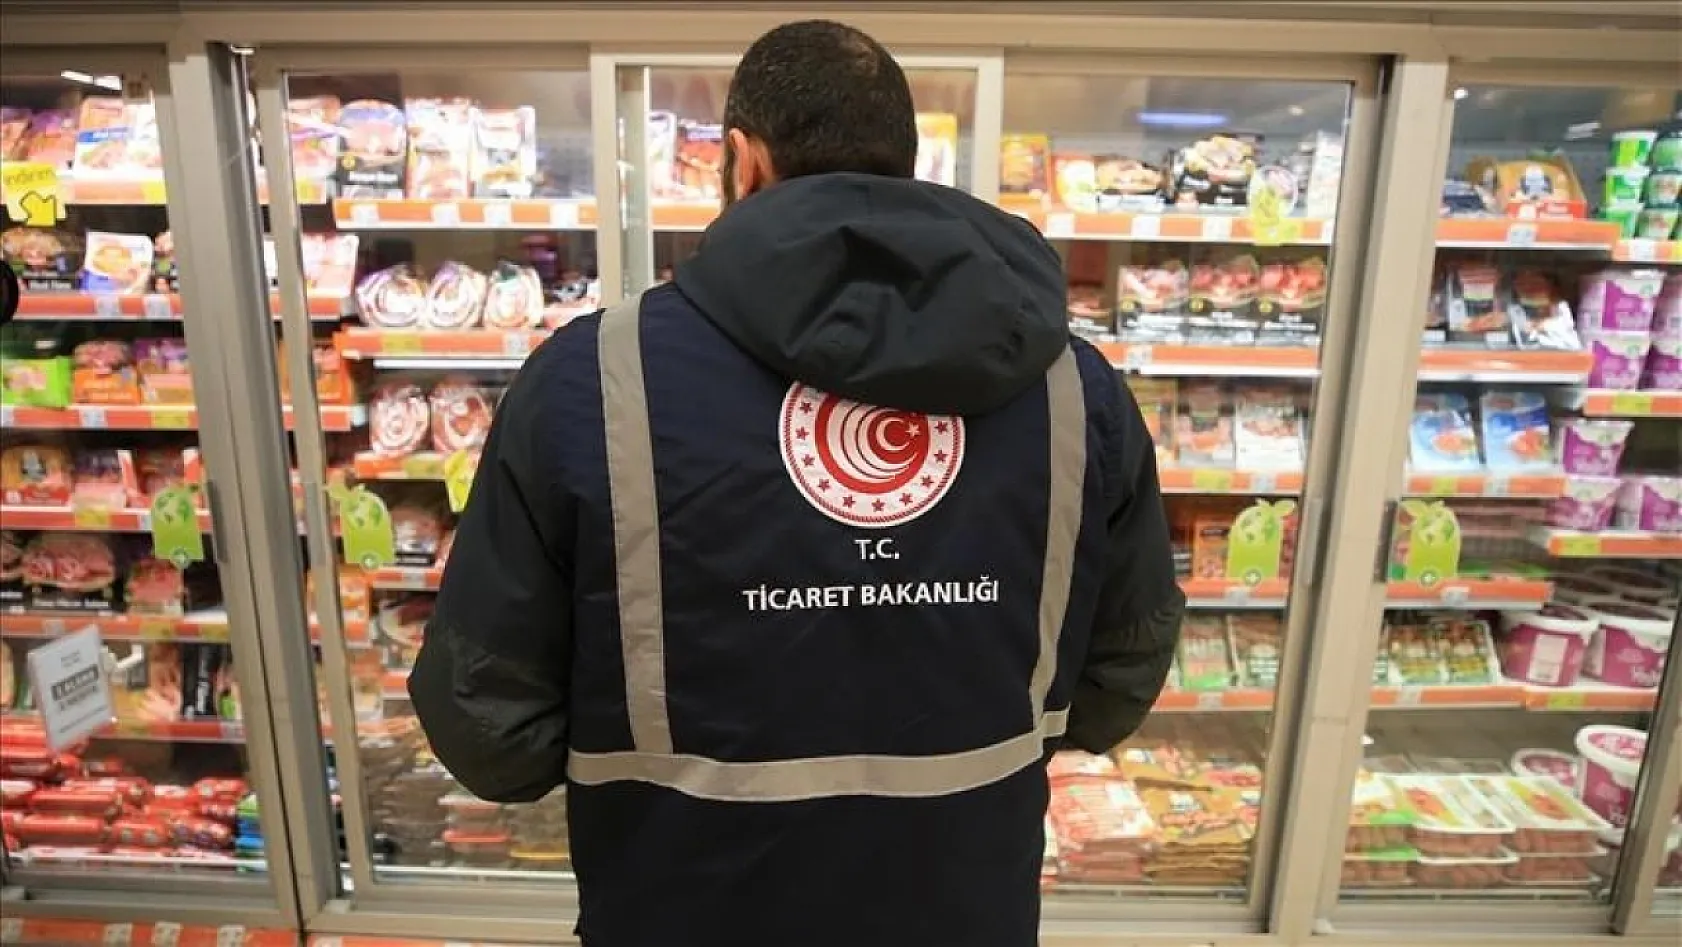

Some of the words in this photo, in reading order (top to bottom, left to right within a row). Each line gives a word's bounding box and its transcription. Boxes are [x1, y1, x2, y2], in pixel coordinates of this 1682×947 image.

[854, 538, 900, 560] T.C.
[742, 584, 856, 611] TİCARET
[860, 574, 1000, 607] BAKANLIĞI
